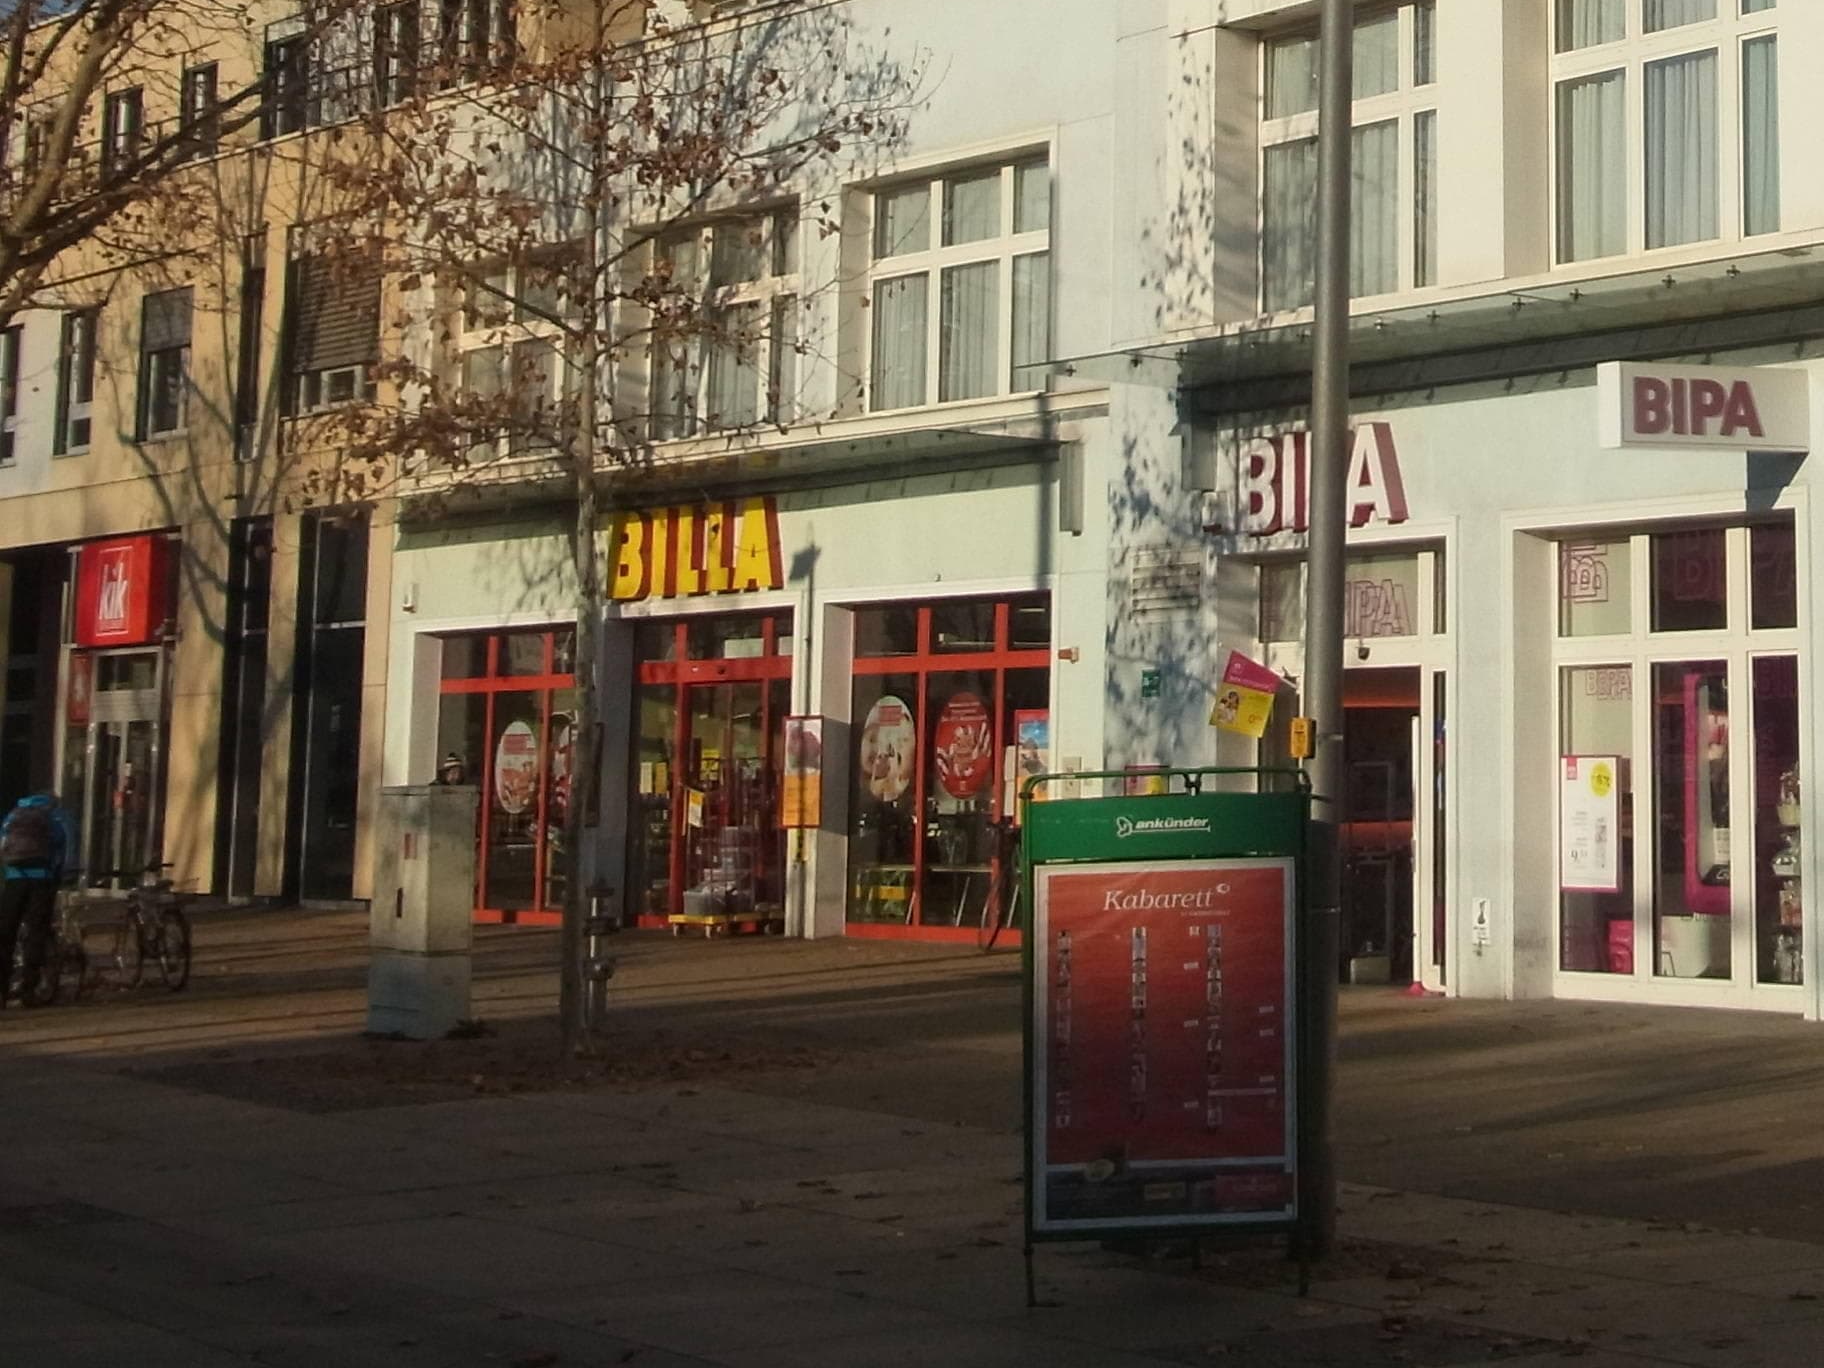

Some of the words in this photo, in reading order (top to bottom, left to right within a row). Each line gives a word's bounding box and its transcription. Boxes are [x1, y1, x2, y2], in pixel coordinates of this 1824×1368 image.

[1633, 376, 1765, 437] BIPA
[1239, 422, 1409, 537] BIA
[606, 497, 784, 602] BILLA
[1135, 817, 1209, 829] ankünder
[1103, 889, 1213, 911] Kabarett
